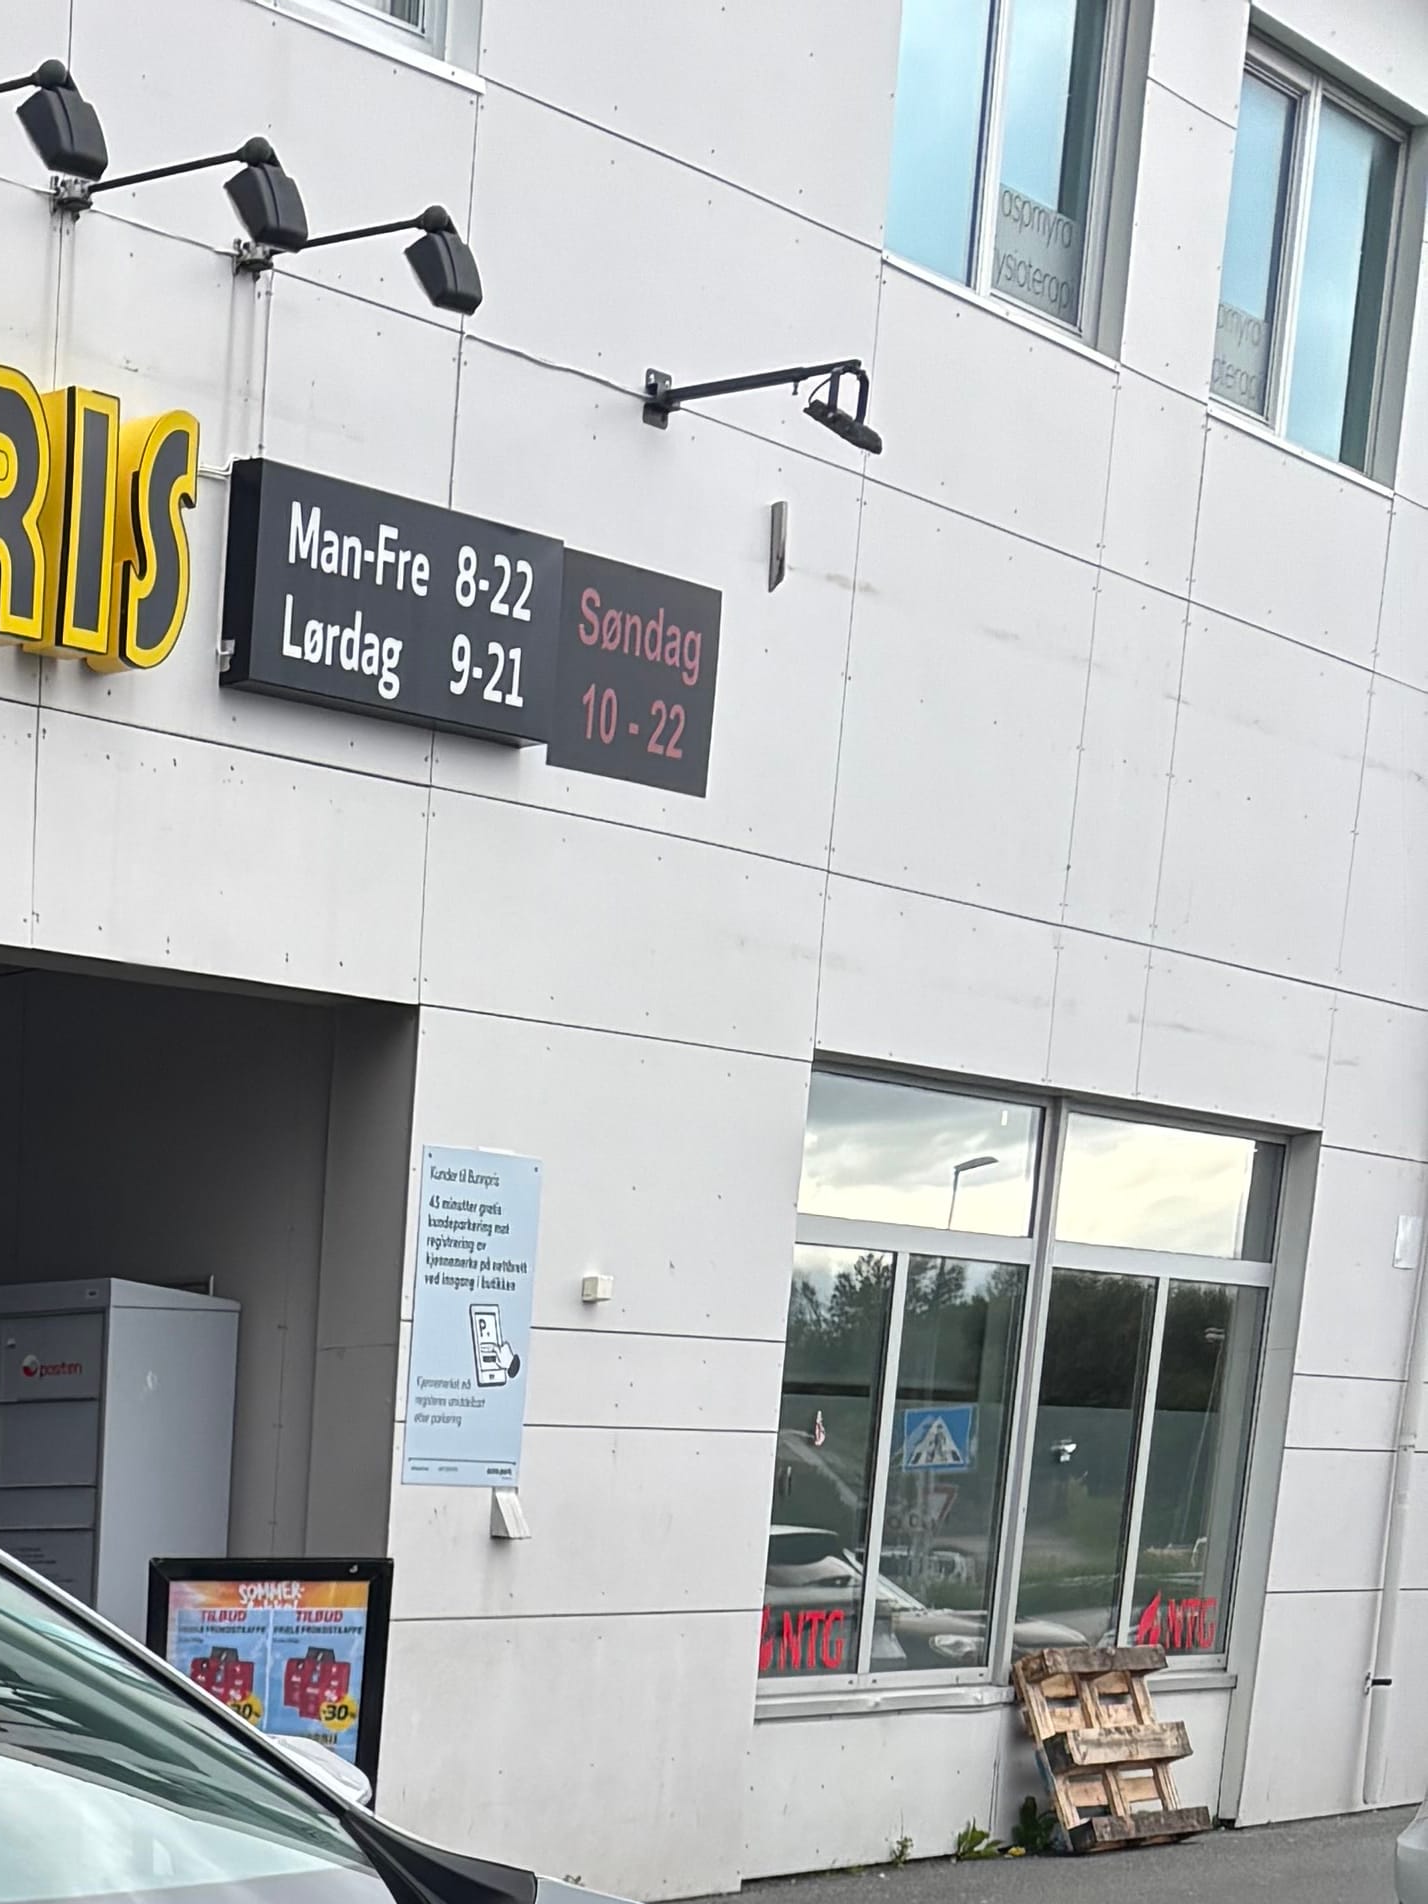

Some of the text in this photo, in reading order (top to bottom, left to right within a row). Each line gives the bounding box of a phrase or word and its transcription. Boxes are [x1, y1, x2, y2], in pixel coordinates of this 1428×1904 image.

[287, 500, 535, 621] Man-Fre 8-22
[281, 593, 524, 708] Lørdag 9-21
[578, 588, 702, 686] Søndag
[582, 683, 618, 744] 10
[647, 699, 686, 760] 22
[40, 1362, 83, 1378] posten
[778, 1609, 844, 1671] NTG
[1165, 1596, 1217, 1648] NTG
